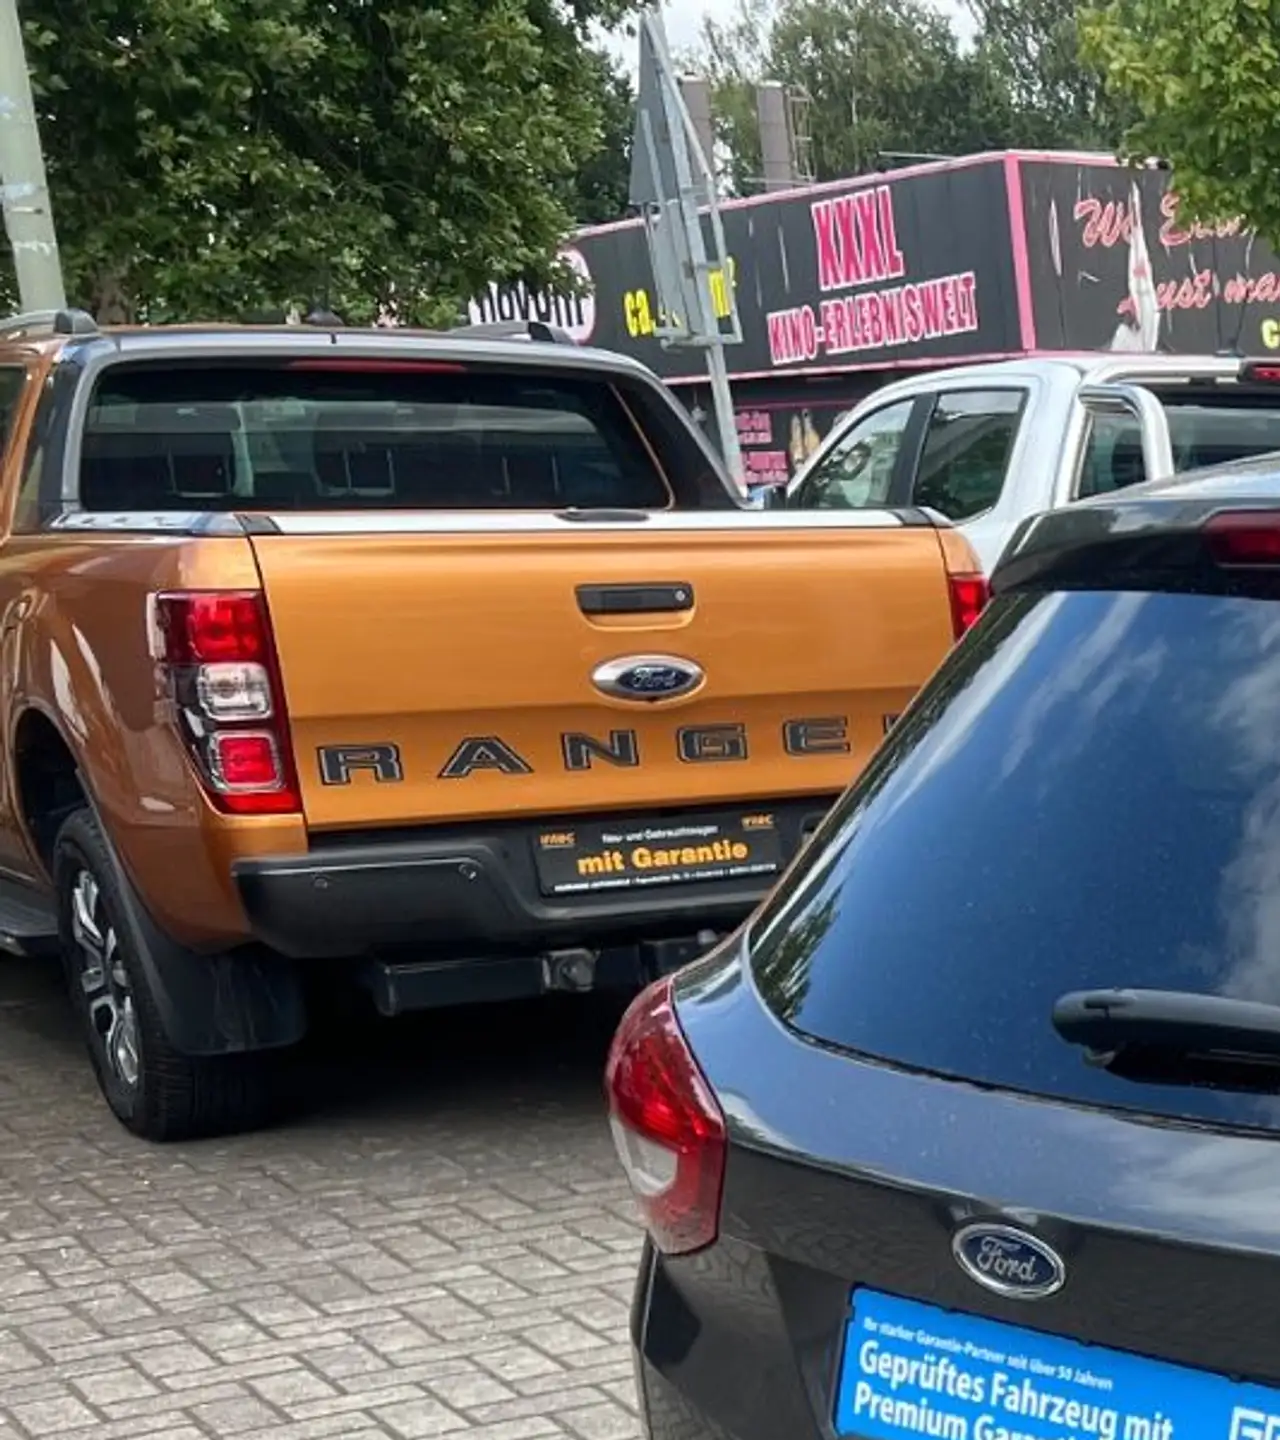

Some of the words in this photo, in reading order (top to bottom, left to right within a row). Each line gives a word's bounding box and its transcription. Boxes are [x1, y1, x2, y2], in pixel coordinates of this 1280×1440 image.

[812, 186, 903, 291] XXXL
[767, 271, 978, 365] KINO-ERLEBNISWELT
[316, 713, 902, 787] RANGE
[577, 852, 625, 875] mit
[632, 839, 749, 869] Garantie
[977, 1236, 1038, 1281] Ford
[859, 1339, 985, 1403] Geprüftes
[863, 1316, 878, 1331] Ihr
[879, 1322, 917, 1342] starker
[917, 1329, 1005, 1364] Garantie-Partner
[1007, 1353, 1028, 1371] seit
[1073, 1368, 1113, 1391] Jahren
